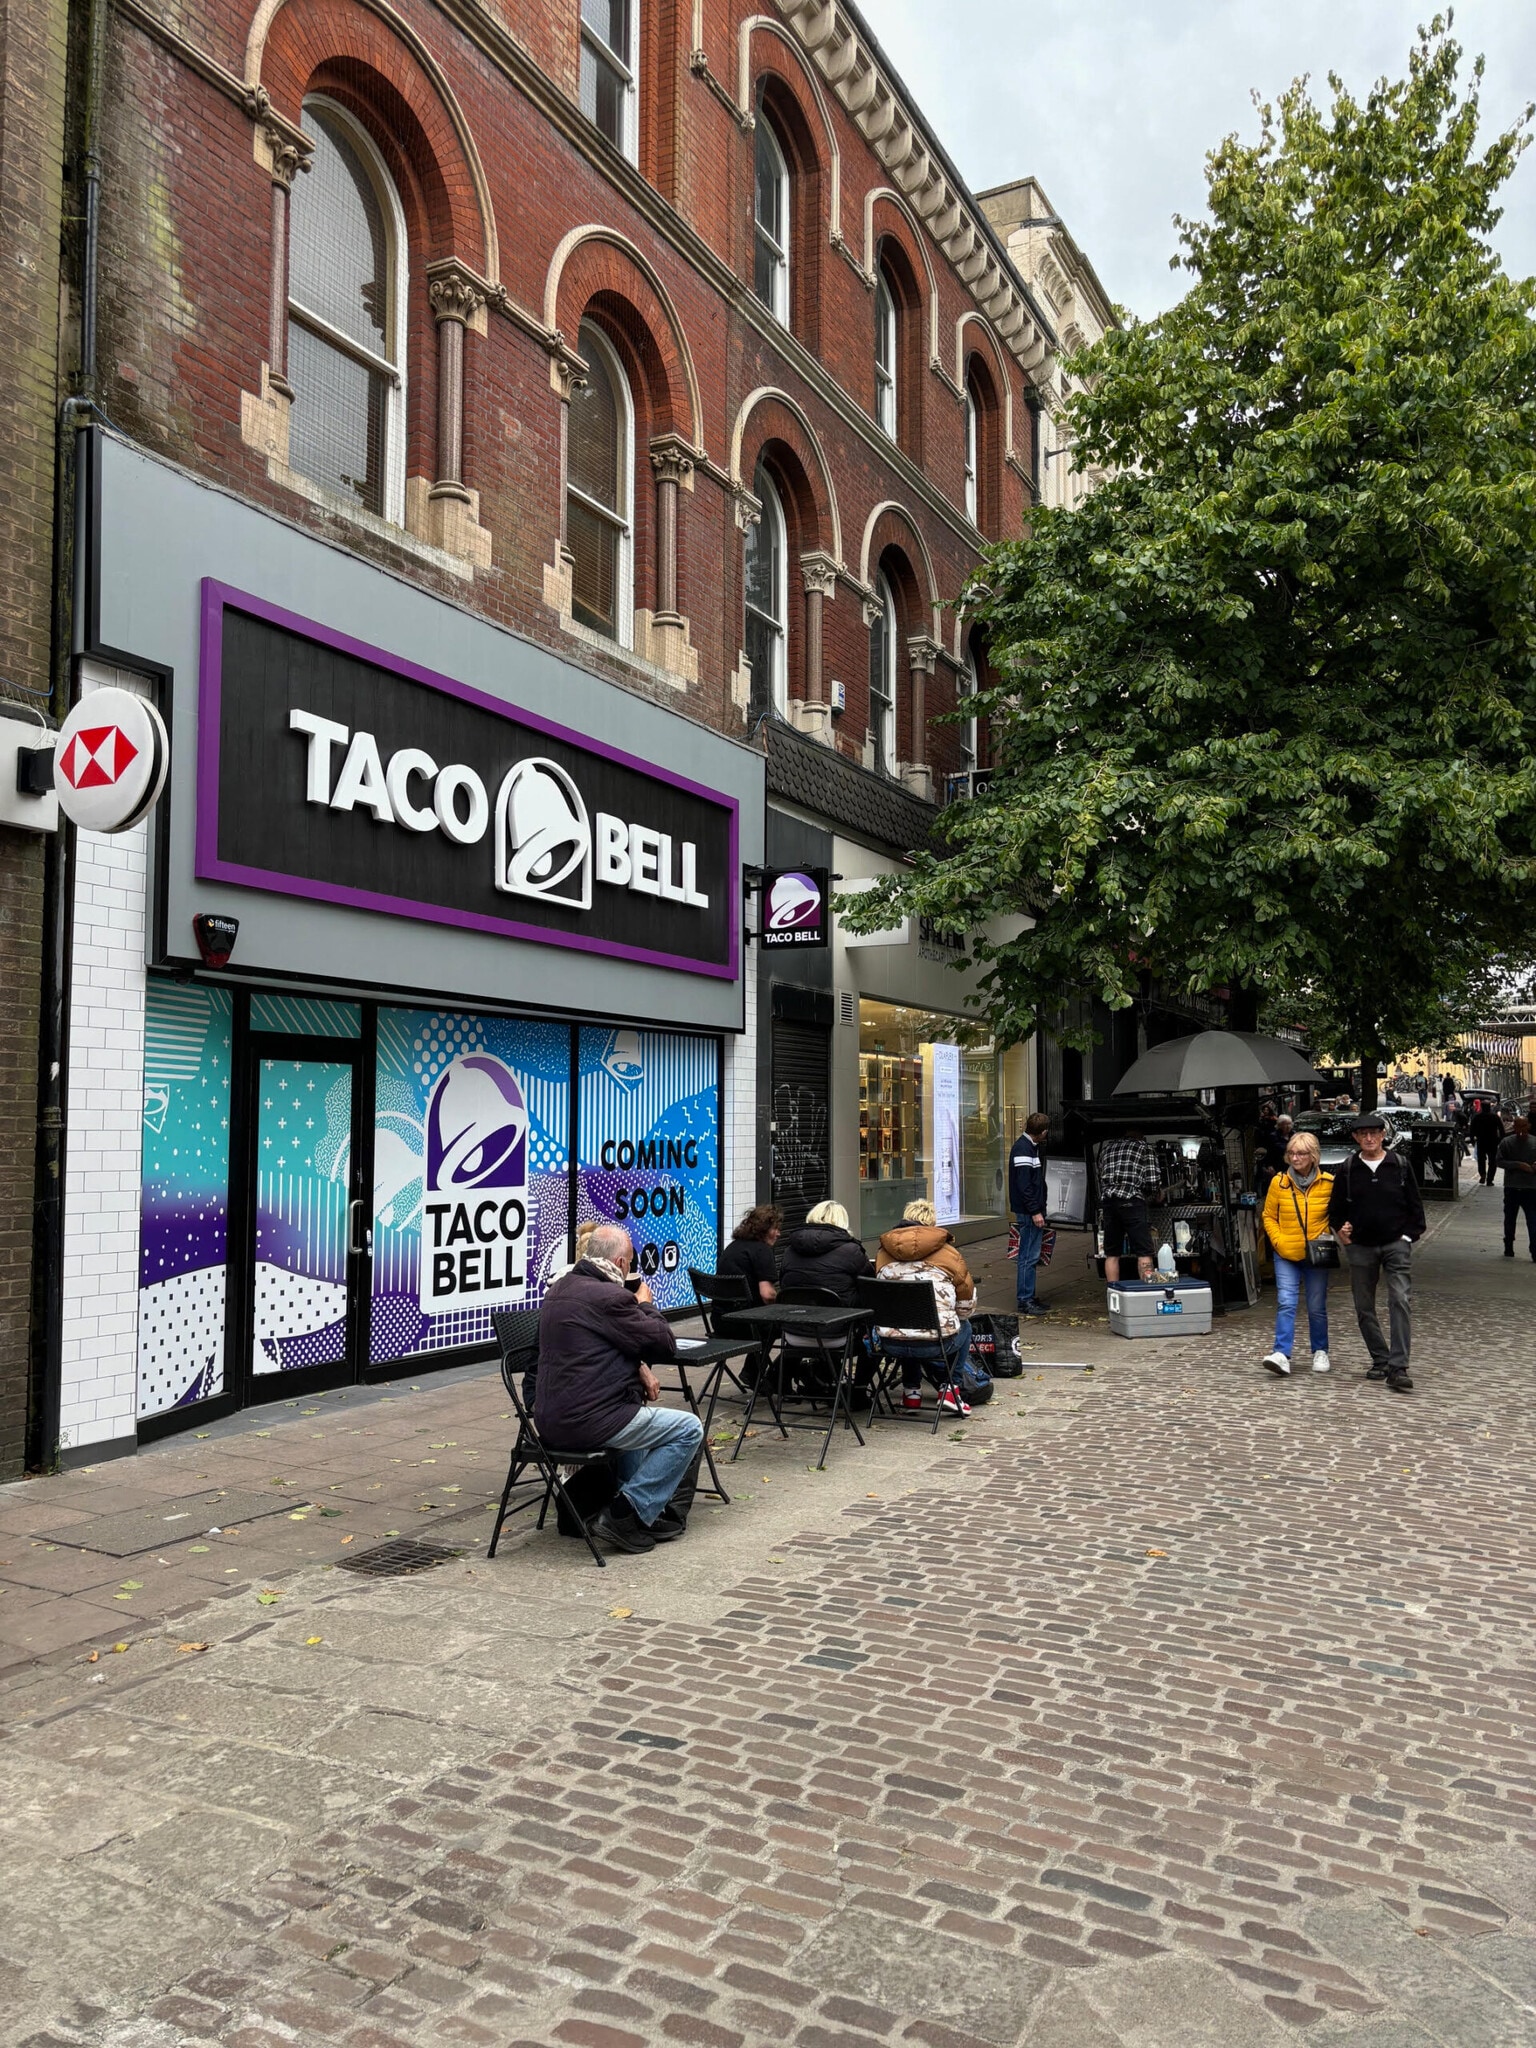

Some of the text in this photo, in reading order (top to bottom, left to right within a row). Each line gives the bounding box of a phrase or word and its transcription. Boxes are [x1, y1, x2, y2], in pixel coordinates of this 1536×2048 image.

[290, 709, 709, 908] TACO BELL
[765, 931, 821, 943] TACO BELL
[601, 1139, 698, 1171] COMING
[425, 1198, 526, 1248] TACO
[615, 1186, 685, 1220] SOON
[432, 1245, 523, 1297] BELL
